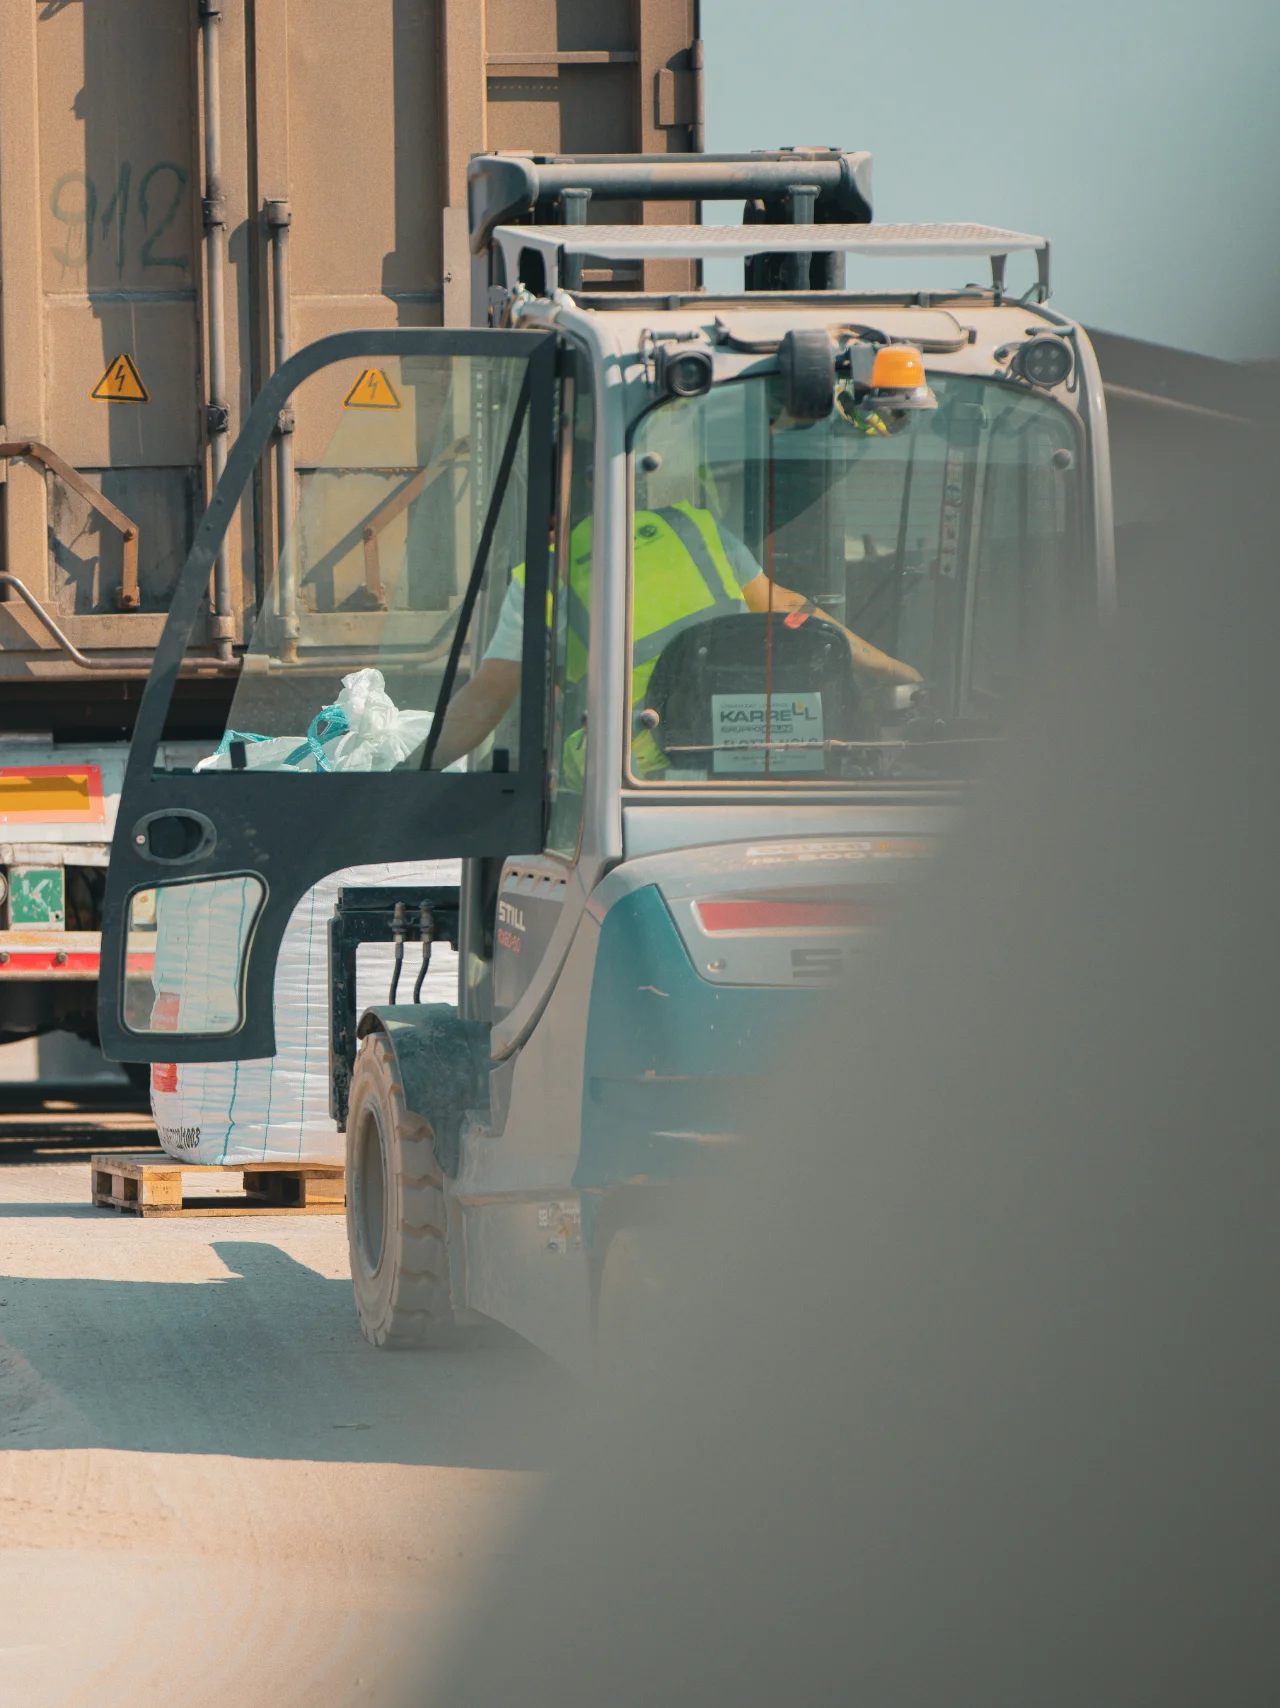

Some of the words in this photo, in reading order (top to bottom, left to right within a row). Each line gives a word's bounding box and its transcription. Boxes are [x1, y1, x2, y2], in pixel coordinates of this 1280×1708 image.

[50, 160, 188, 280] 912
[720, 702, 818, 722] KARRELL
[499, 900, 526, 932] STILL
